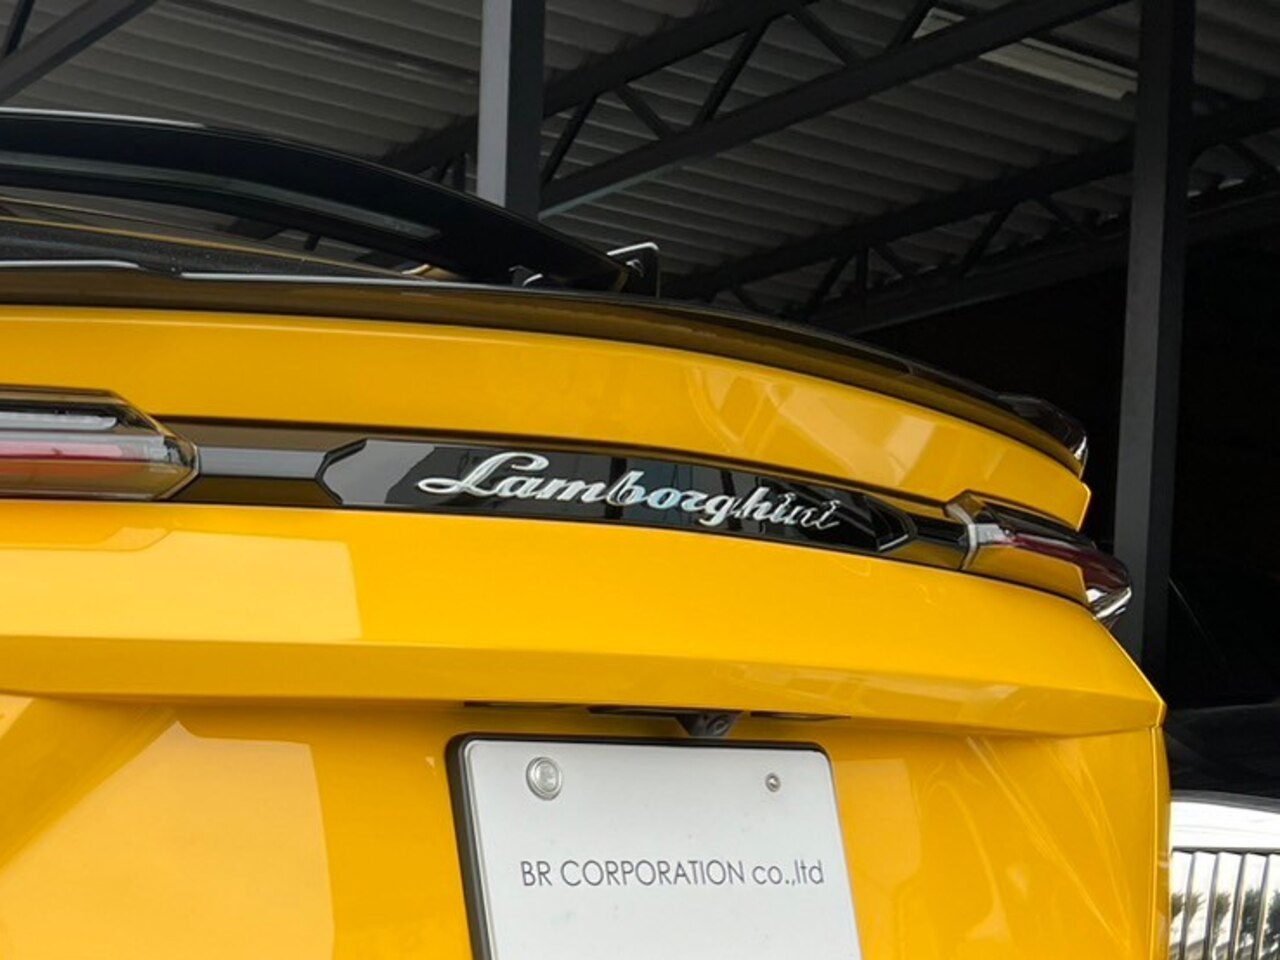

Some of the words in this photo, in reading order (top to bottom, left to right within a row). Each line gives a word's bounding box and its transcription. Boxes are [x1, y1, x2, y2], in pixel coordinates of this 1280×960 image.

[418, 452, 841, 531] Lamborghini
[521, 860, 553, 887] BR
[561, 859, 746, 887] CORPORATION
[752, 859, 825, 887] co.,ltd
